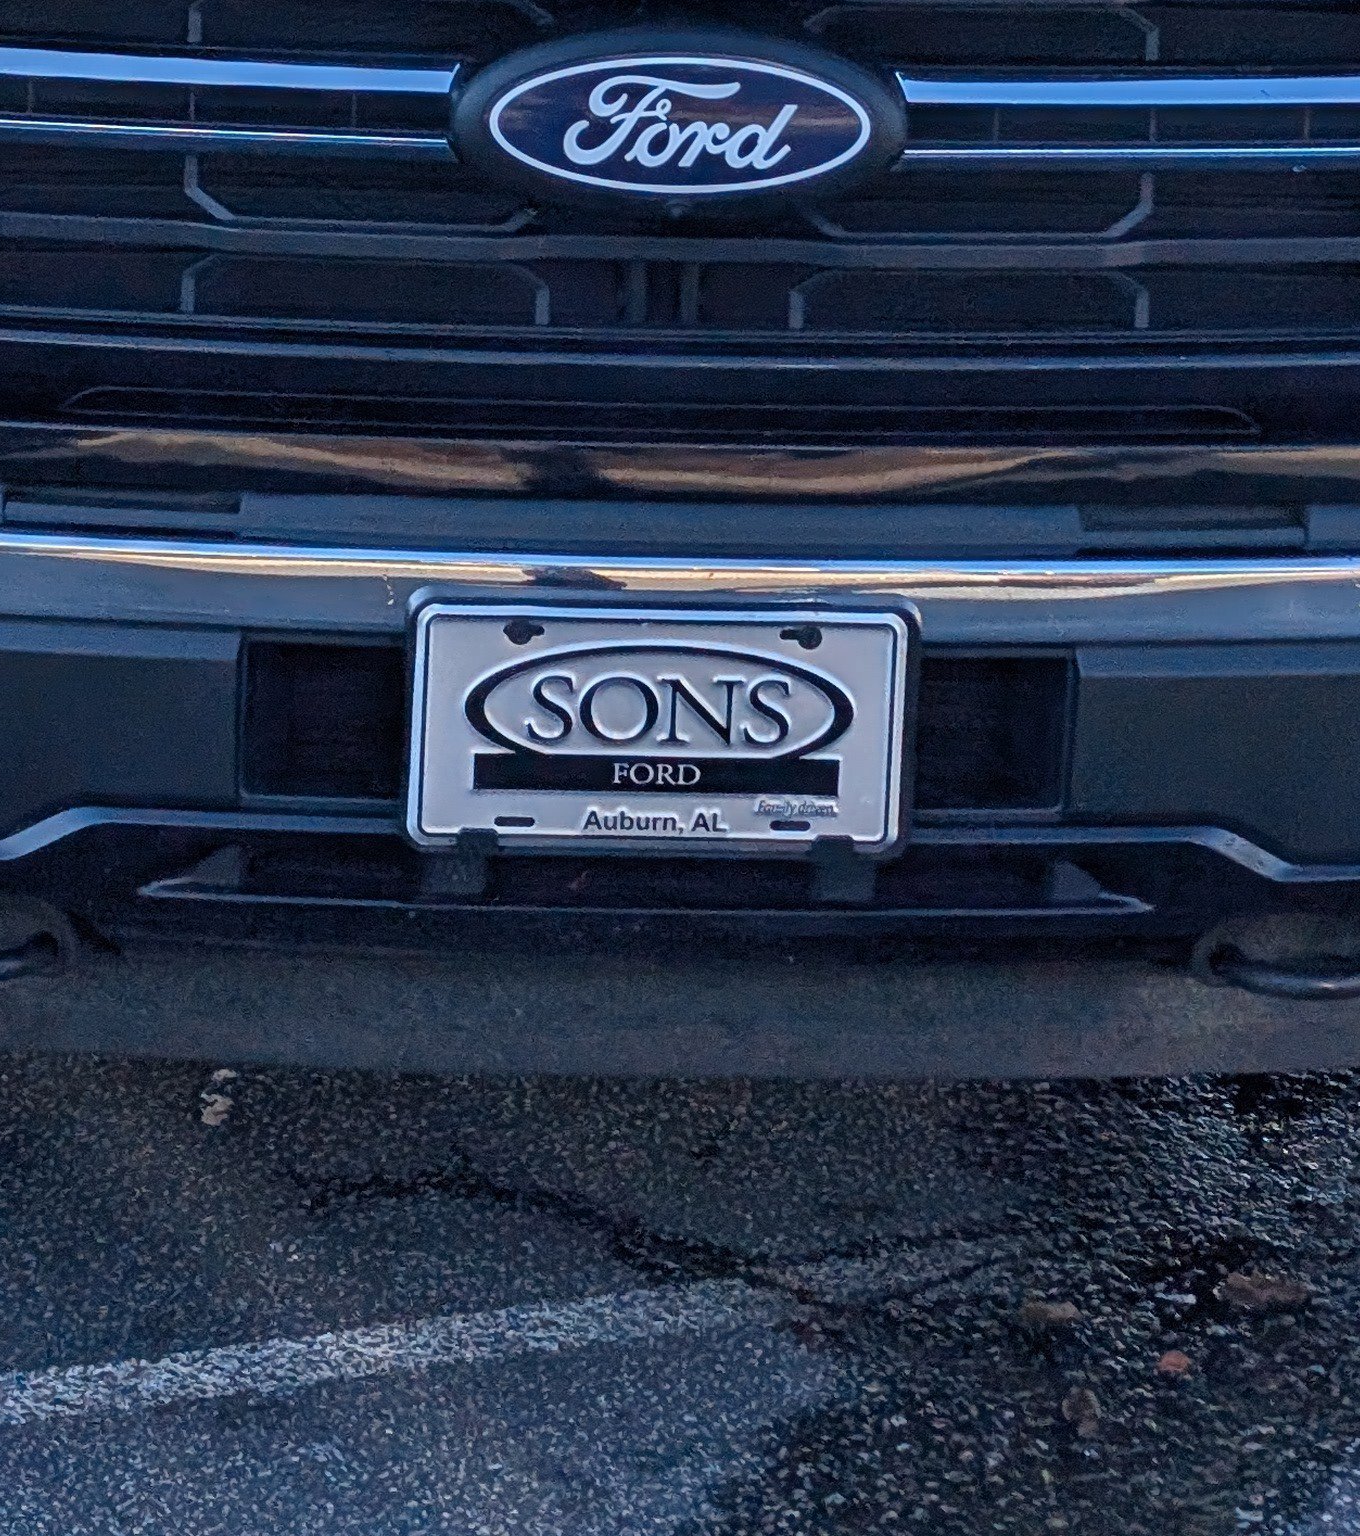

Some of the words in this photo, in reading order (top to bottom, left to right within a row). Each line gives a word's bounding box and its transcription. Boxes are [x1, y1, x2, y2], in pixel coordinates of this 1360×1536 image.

[562, 75, 798, 170] Ford
[524, 673, 793, 748] SONS
[611, 762, 702, 788] FORD
[582, 809, 685, 834] Auburn,
[691, 812, 728, 833] AL
